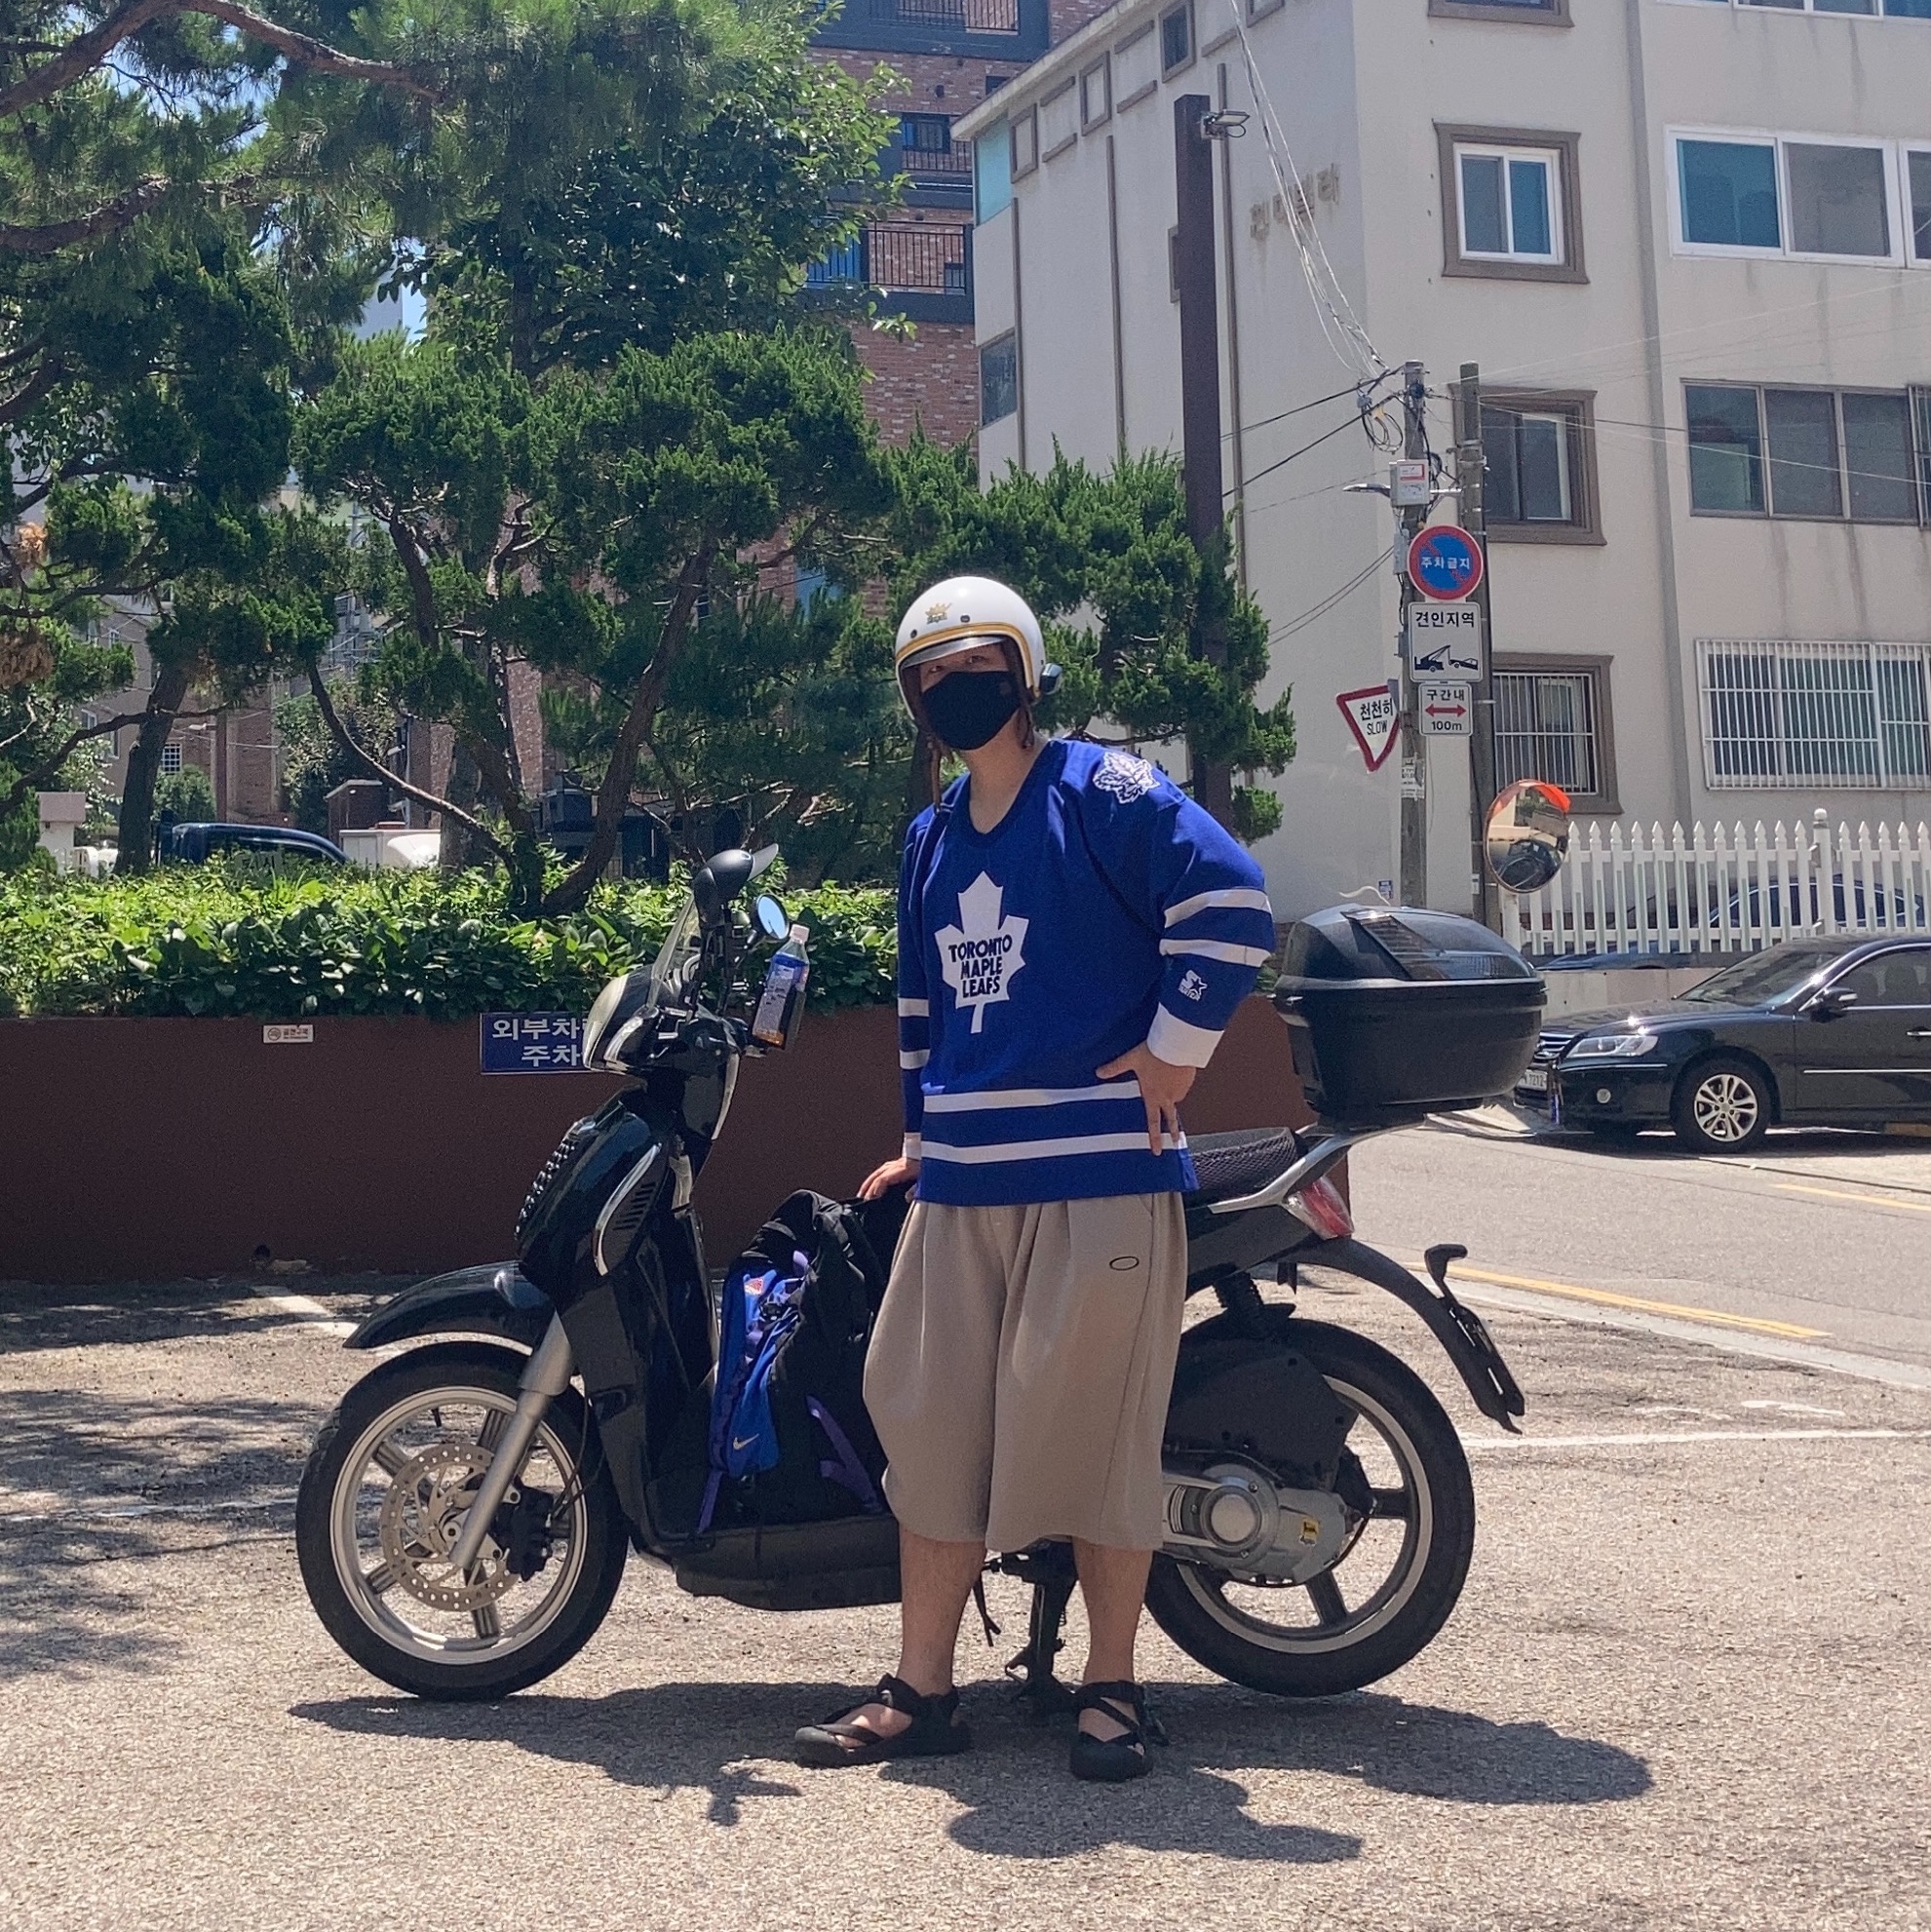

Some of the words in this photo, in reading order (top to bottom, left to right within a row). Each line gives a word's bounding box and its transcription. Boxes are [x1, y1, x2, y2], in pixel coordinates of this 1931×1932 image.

[1421, 557, 1471, 570] 주차금지
[1415, 611, 1475, 629] 견인지역
[1426, 688, 1465, 701] 구간내
[1360, 697, 1394, 720] 천천히
[1367, 721, 1388, 735] SLOW
[1431, 720, 1462, 731] 100m
[948, 934, 1013, 962] TORONTO
[960, 956, 1003, 980] MAPLE
[962, 976, 1000, 998] LEAFS
[492, 1017, 588, 1040] 외부차
[521, 1044, 583, 1067] 주차
